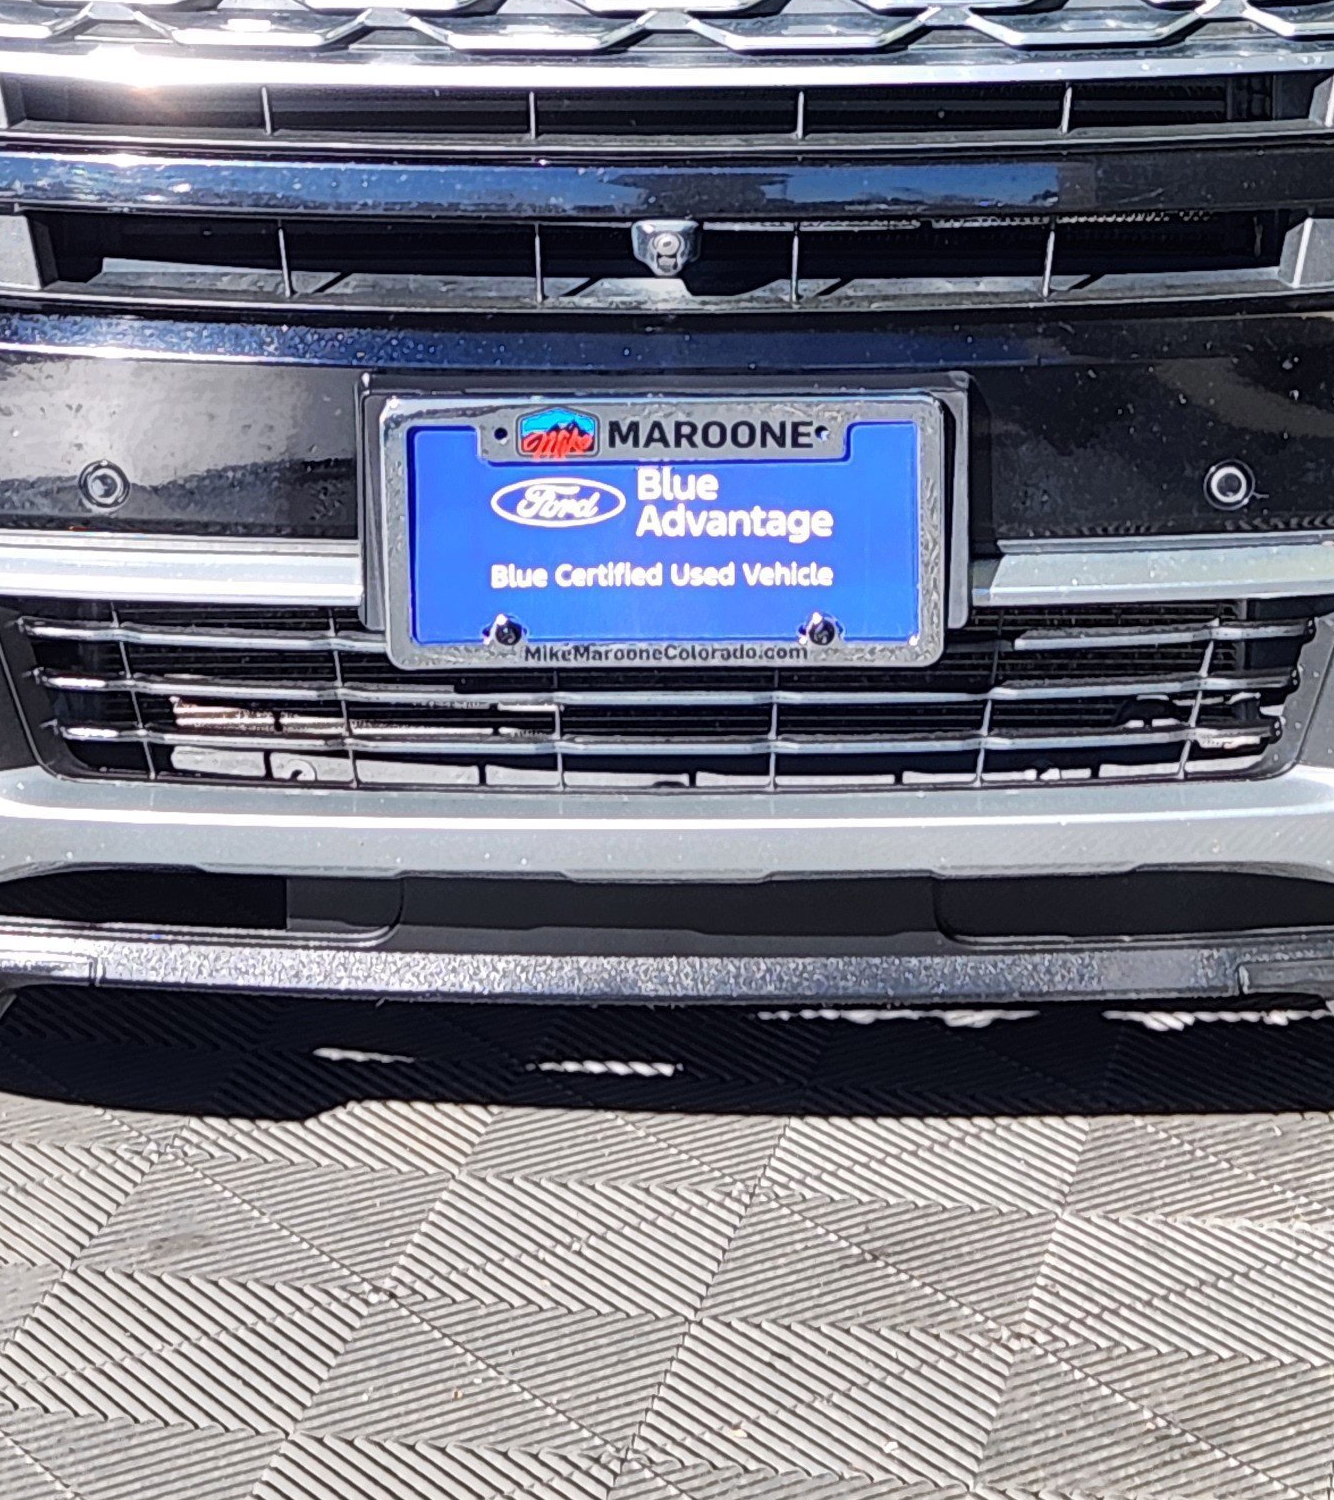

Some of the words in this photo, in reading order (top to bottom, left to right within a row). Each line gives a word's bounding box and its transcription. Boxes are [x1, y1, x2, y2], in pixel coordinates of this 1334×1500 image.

[522, 427, 595, 459] Mike
[608, 419, 814, 449] MAROONE
[636, 466, 720, 501] Blue
[516, 484, 600, 519] Ford
[635, 503, 835, 544] Advantage
[490, 563, 549, 588] Blue
[554, 561, 664, 588] Certified
[670, 561, 736, 588] Used
[742, 560, 834, 588] Vehicle
[524, 643, 809, 663] MikeMarooneColorado.com
